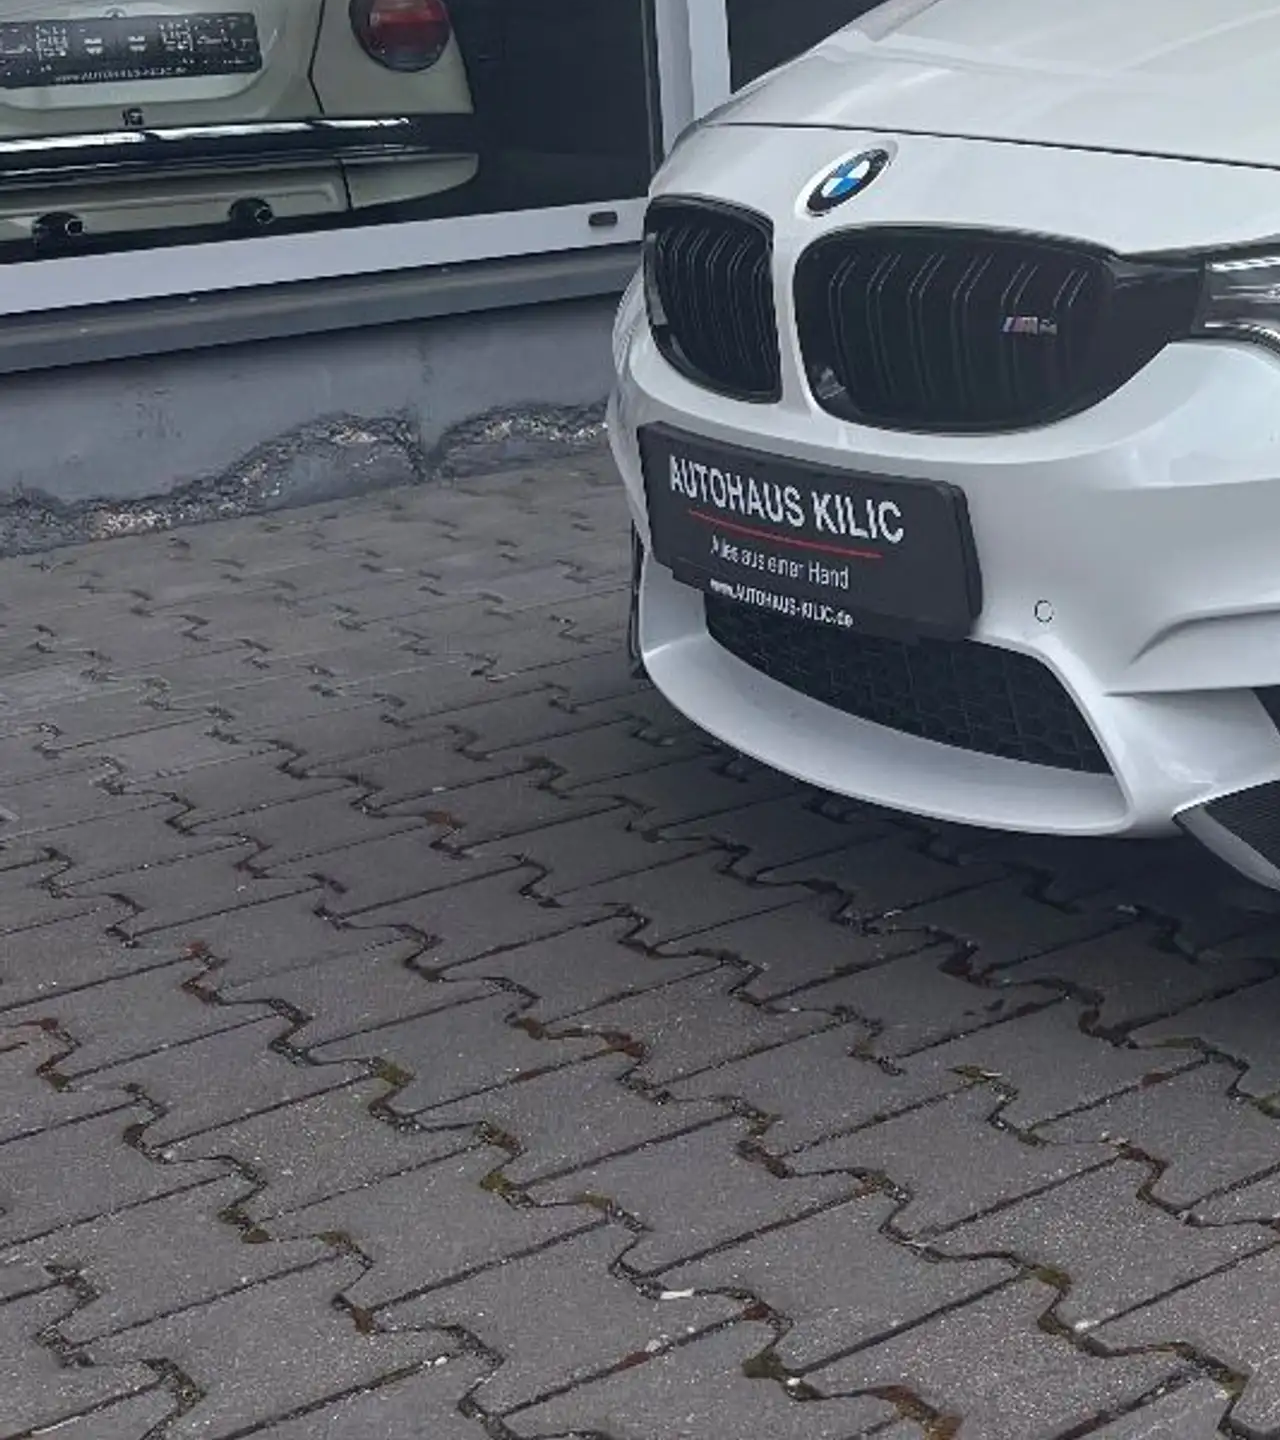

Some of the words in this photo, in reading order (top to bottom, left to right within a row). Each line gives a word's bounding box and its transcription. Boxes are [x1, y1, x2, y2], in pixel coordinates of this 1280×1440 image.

[669, 454, 805, 528] AUTOHAUS
[811, 490, 904, 544] KILIC
[808, 559, 849, 590] Hand
